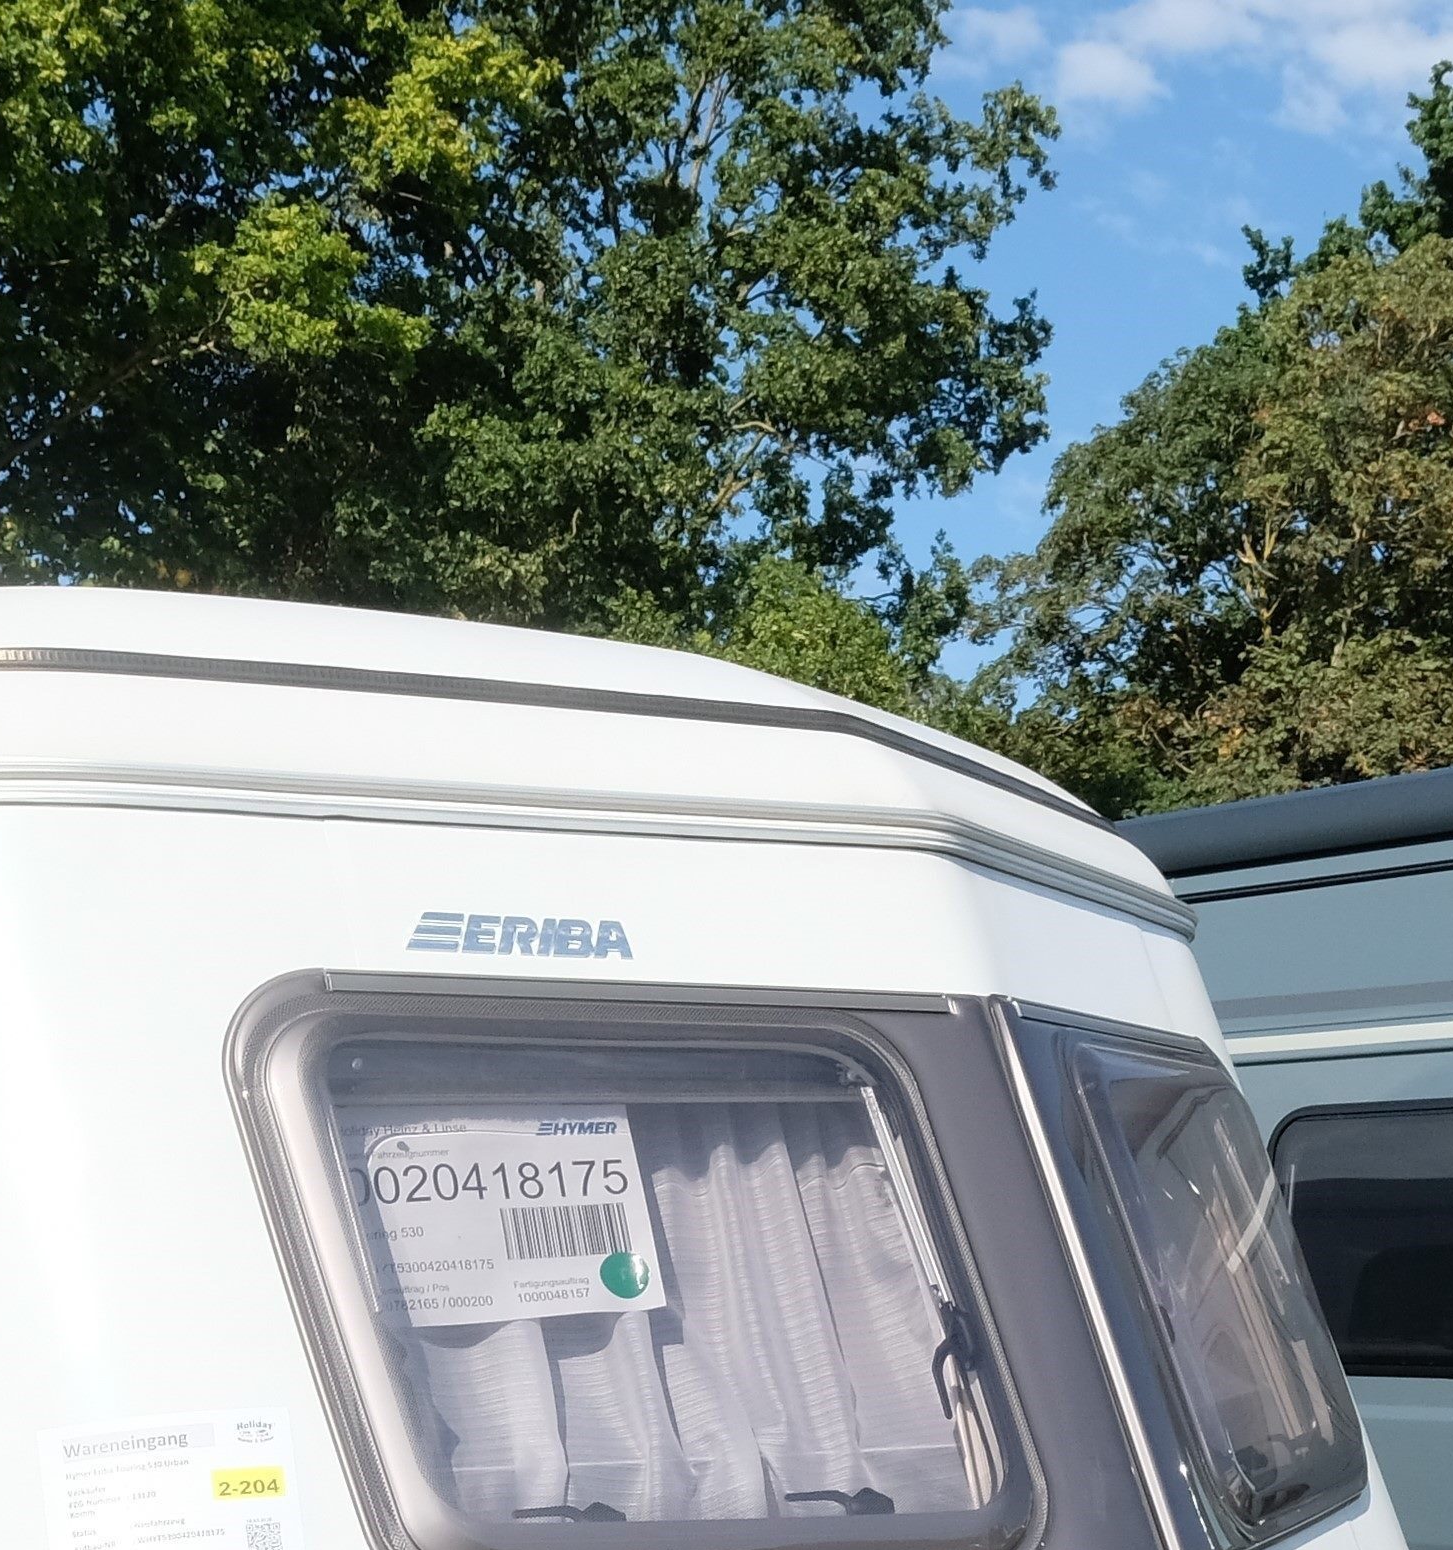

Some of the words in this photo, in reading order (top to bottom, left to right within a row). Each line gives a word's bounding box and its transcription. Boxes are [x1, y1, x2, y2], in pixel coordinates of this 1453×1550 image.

[460, 914, 634, 960] ERIBA
[552, 1121, 618, 1136] HYMER
[373, 1148, 450, 1160] ahrzeugnummer
[400, 1226, 425, 1238] 530
[448, 1295, 494, 1309] 000200
[518, 1287, 590, 1303] 1000048157
[236, 1419, 273, 1432] Holiday
[62, 1431, 189, 1459] Wareneingang
[218, 1478, 280, 1497] 2-204
